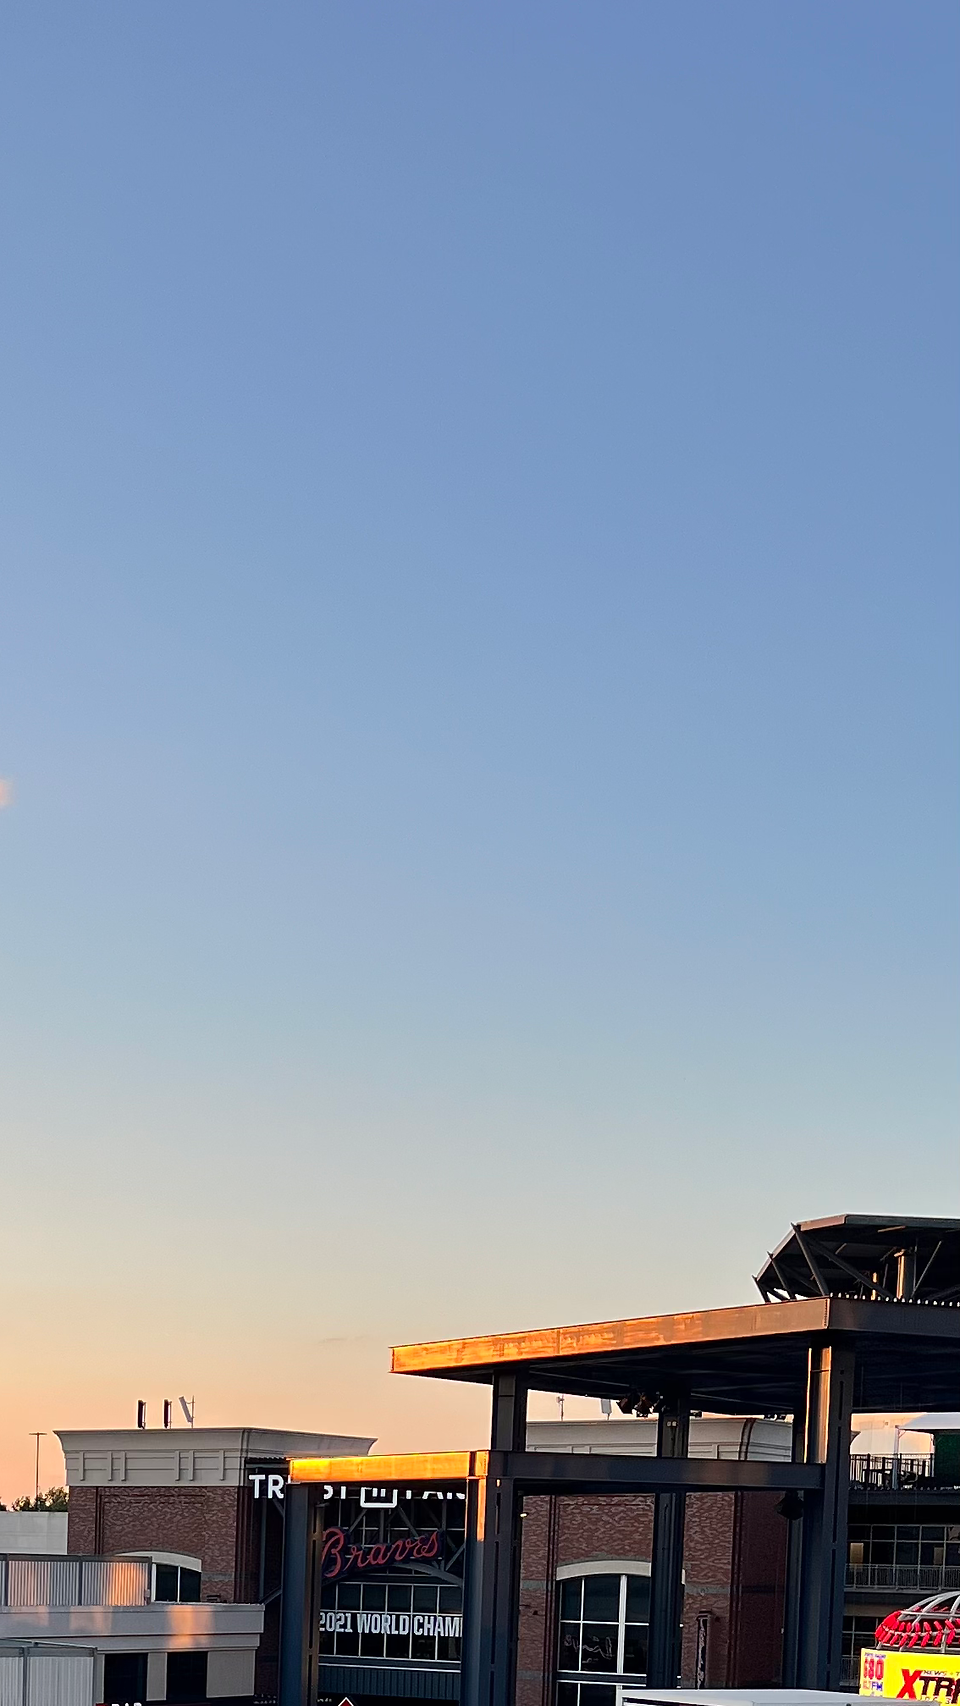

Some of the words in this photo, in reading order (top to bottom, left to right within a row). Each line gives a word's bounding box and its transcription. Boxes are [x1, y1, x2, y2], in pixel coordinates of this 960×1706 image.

[322, 1526, 438, 1578] Braves
[320, 1612, 353, 1633] 2021
[357, 1613, 410, 1635] WORLD
[413, 1615, 463, 1638] CHAM
